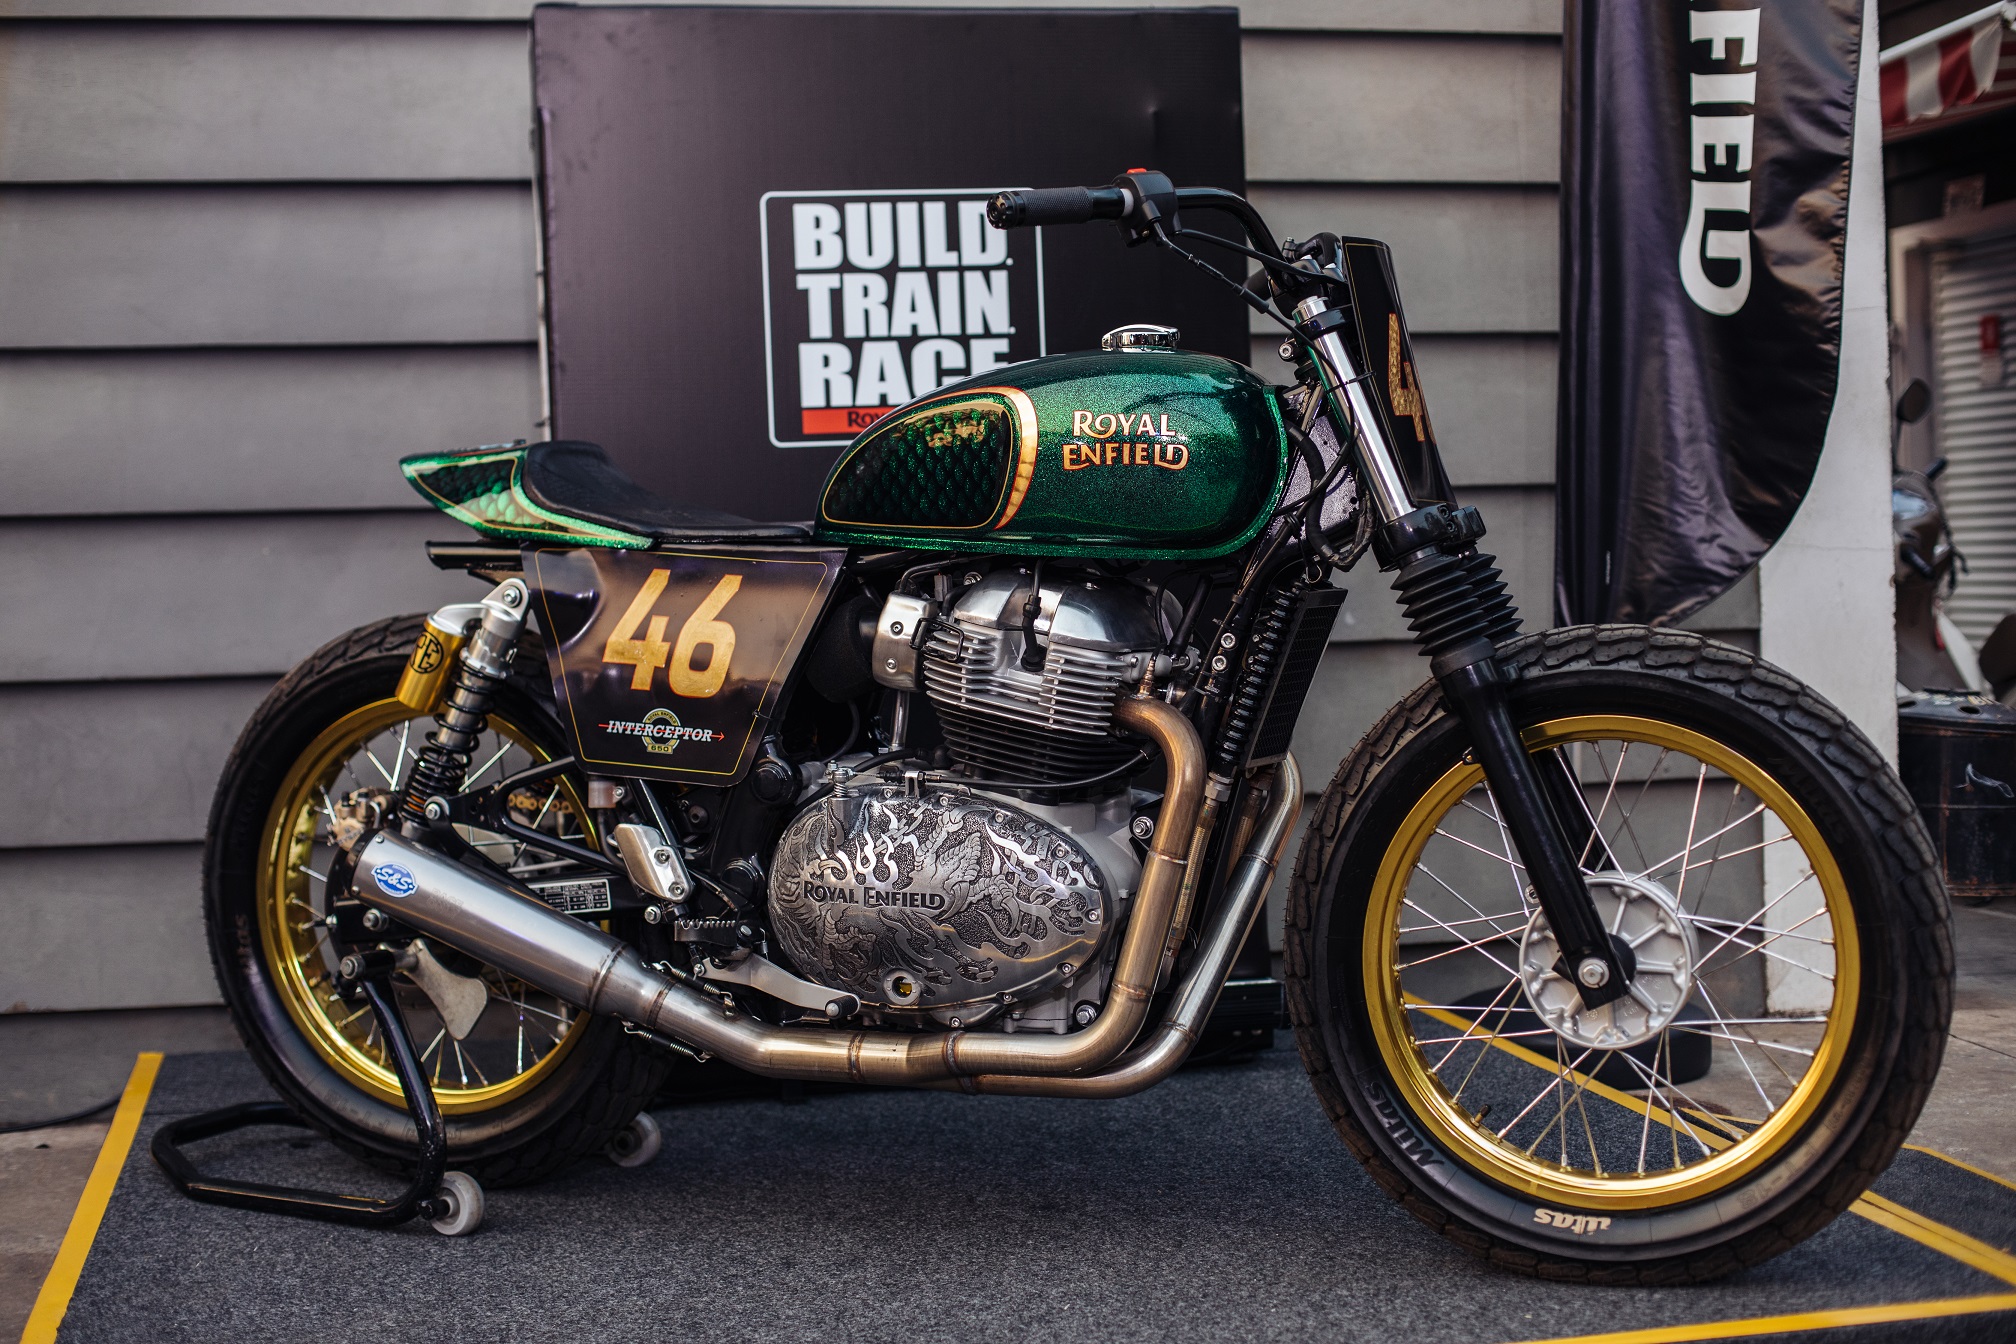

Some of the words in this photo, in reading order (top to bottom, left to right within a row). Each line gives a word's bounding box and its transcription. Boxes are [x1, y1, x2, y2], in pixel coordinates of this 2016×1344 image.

[1679, 8, 1760, 316] FIELD
[792, 201, 1014, 269] BUILD.
[796, 270, 1016, 339] TRAIN.
[1389, 313, 1436, 444] 4
[1062, 442, 1189, 471] ENFIELD
[1072, 410, 1176, 439] ROYAL
[602, 569, 743, 698] 46
[606, 720, 713, 742] INTERCEPTOR
[377, 868, 412, 890] S&S
[803, 880, 859, 904] ROYAL
[863, 886, 946, 911] ENFIELD
[1366, 1081, 1445, 1168] Mitas
